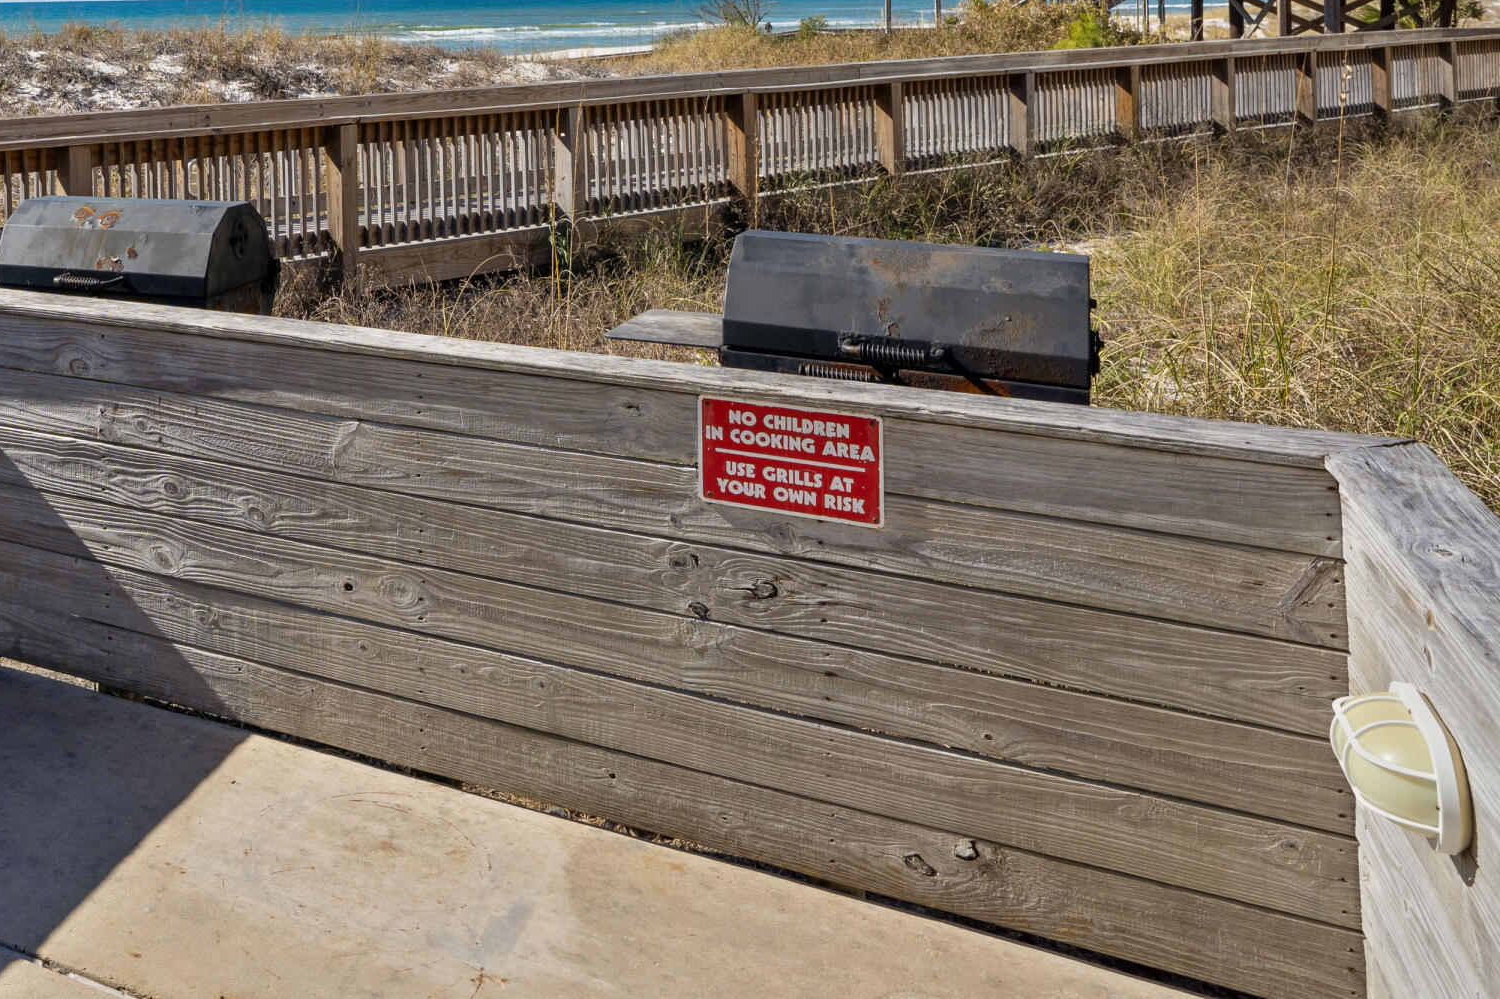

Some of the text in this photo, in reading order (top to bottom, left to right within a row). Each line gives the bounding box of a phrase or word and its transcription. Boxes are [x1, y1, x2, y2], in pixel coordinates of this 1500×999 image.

[728, 409, 849, 438] NO CHILDREN
[705, 425, 874, 461] IN COOKING AREA
[725, 460, 853, 492] USE GRILLS AT
[716, 477, 864, 513] YOUR OWN RISK
